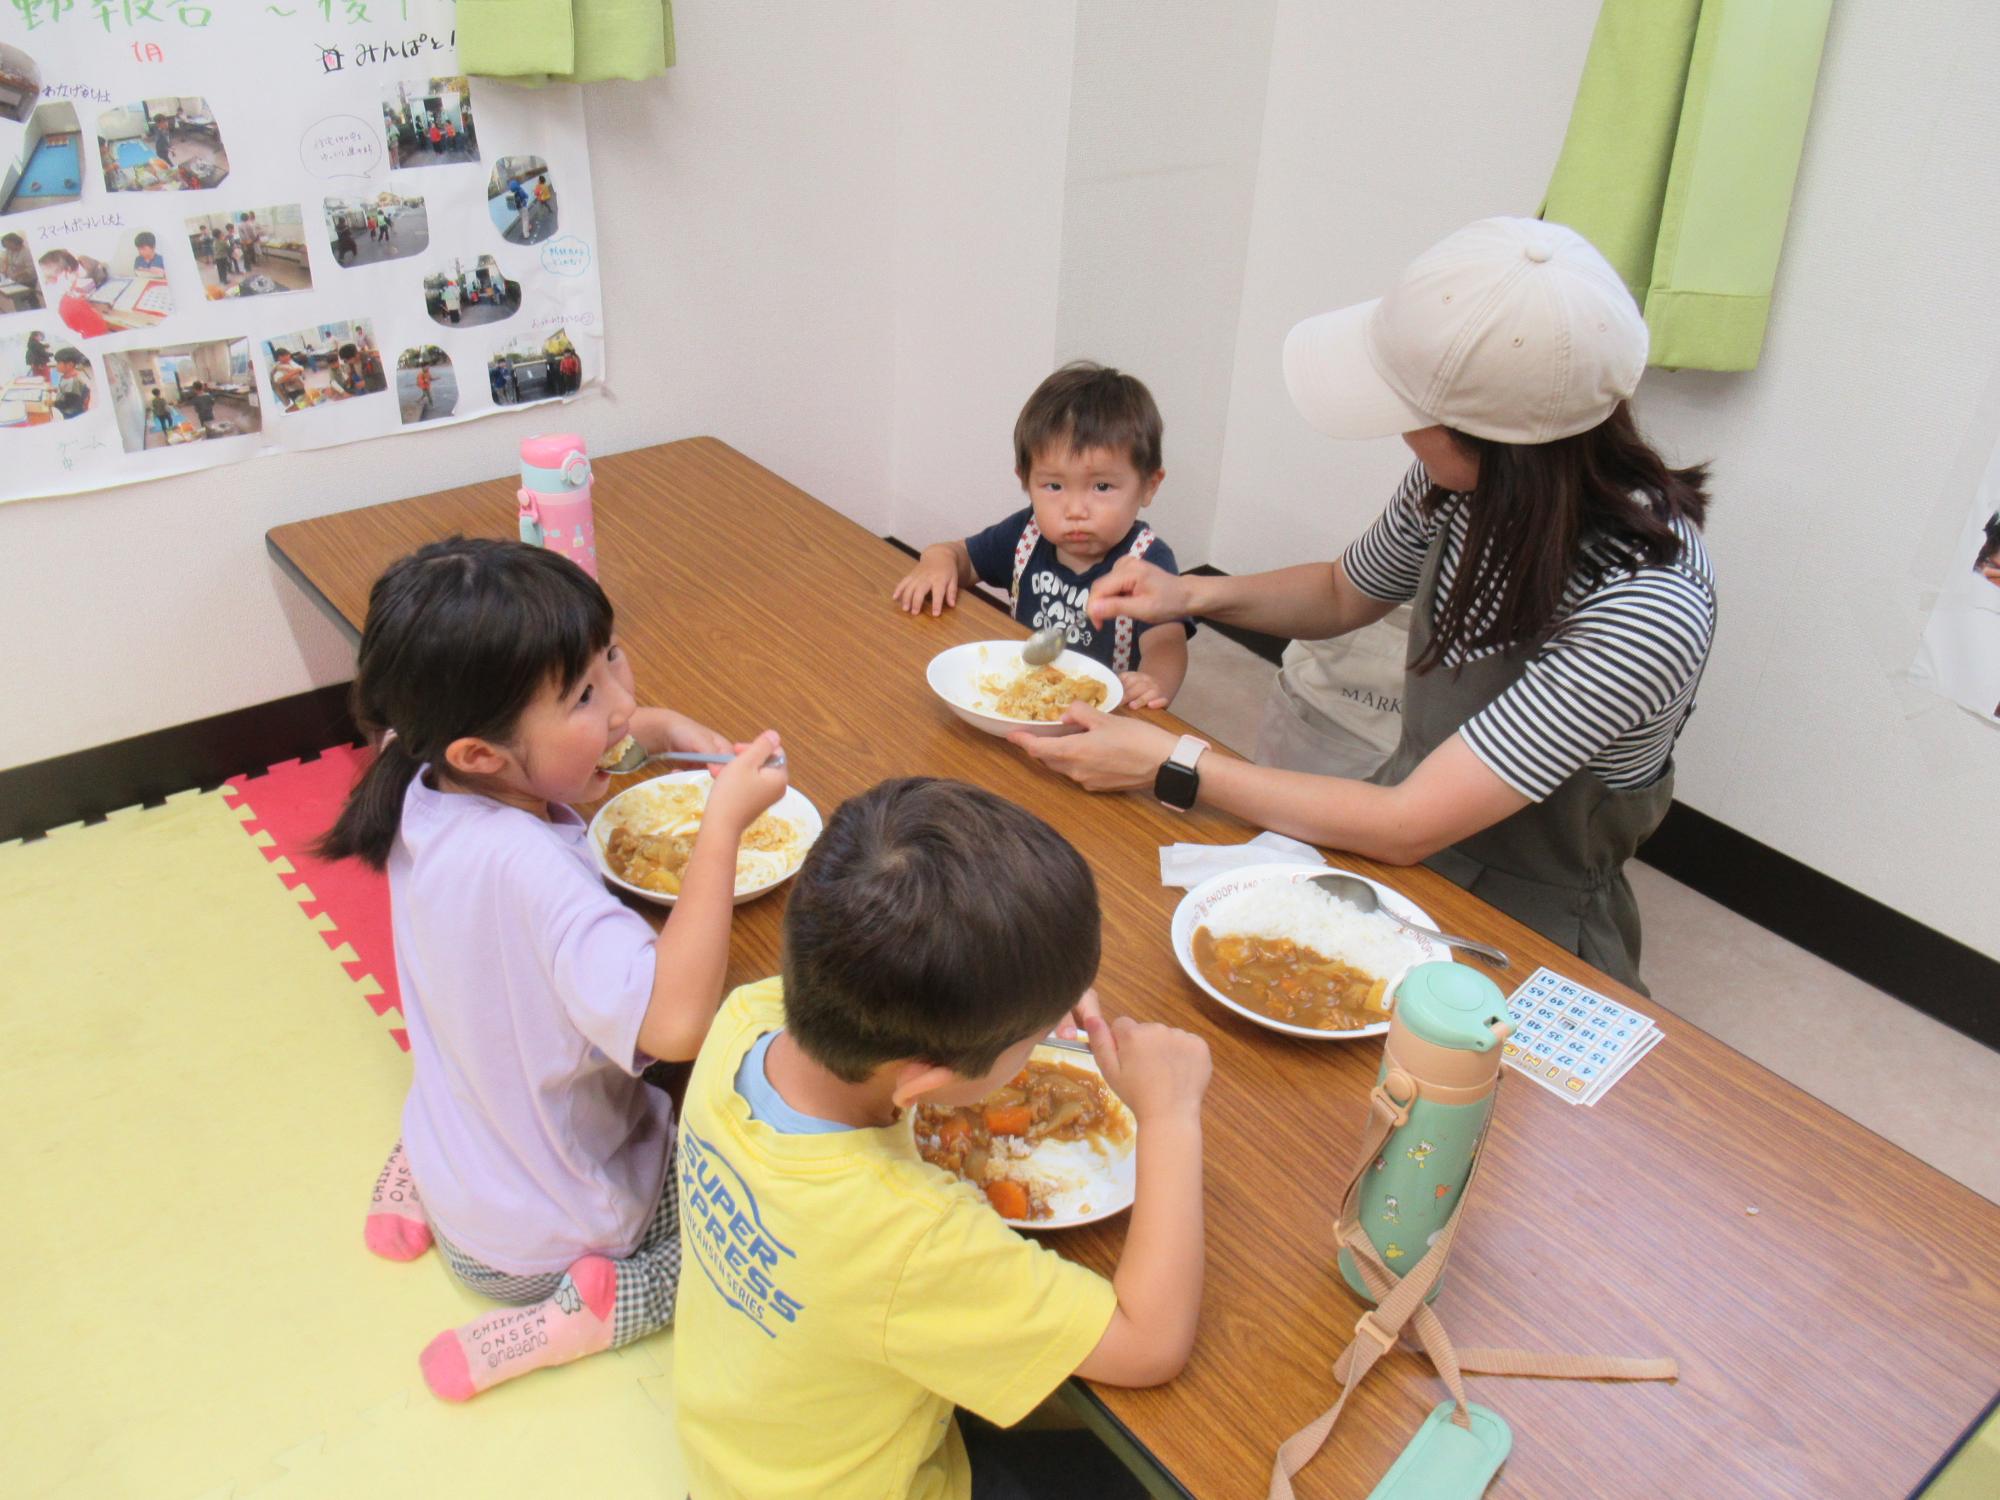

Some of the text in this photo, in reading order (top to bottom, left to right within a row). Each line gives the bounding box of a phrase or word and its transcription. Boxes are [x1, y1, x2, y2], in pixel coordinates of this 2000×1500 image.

[1032, 571, 1089, 612] DRIVIN
[1342, 688, 1401, 714] MARK
[1540, 975, 1555, 985] 61
[1528, 986, 1544, 997] 65
[1561, 985, 1576, 996] 58
[1550, 997, 1565, 1007] 49
[1581, 996, 1597, 1005] 43
[1570, 1006, 1586, 1017] 38
[1603, 1006, 1619, 1016] 28
[1517, 998, 1618, 1051] 13 18 50 63
[1526, 1020, 1542, 1030] 48
[1592, 1017, 1607, 1027] 22
[1514, 1032, 1530, 1043] 53
[1547, 1030, 1563, 1041] 35
[1535, 1043, 1551, 1054] 33
[1569, 1041, 1585, 1052] 29
[1557, 1055, 1573, 1065] 27
[1590, 1053, 1606, 1064] 15
[390, 1158, 413, 1202] ONS
[684, 1133, 779, 1273] SUPER
[728, 1275, 765, 1319] SERIES
[481, 1314, 547, 1355] ONSEN
